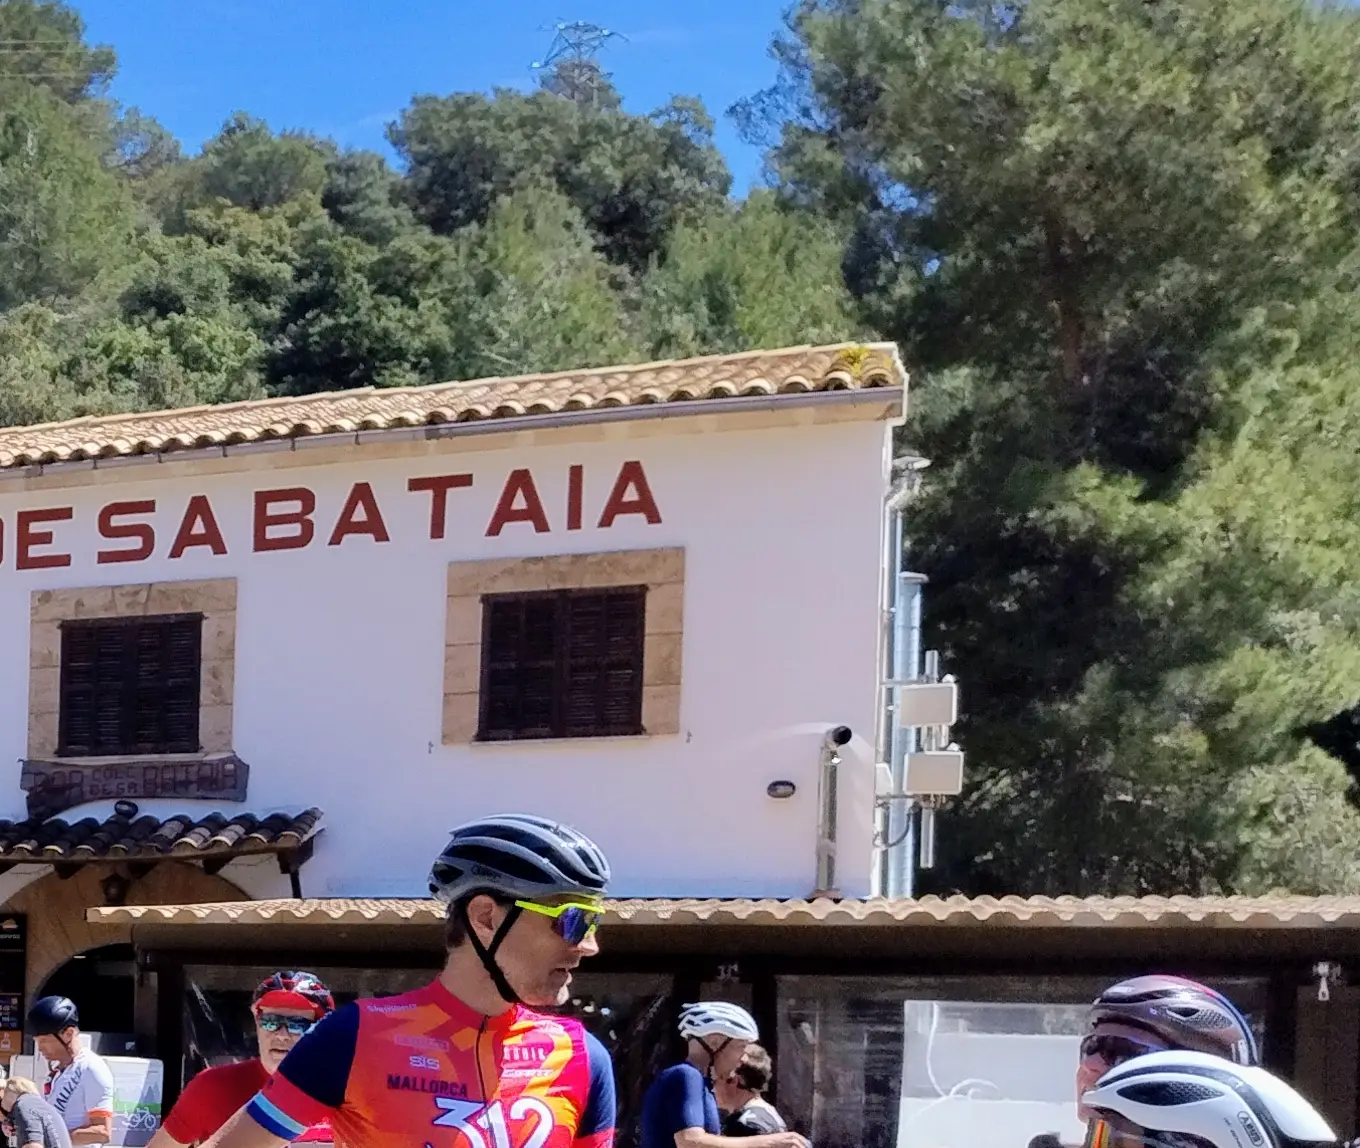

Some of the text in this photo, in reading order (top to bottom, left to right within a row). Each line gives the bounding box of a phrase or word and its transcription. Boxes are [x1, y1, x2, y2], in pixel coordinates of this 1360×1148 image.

[97, 495, 228, 565] SA
[254, 460, 662, 552] BATAIA
[387, 1073, 468, 1098] MALLORCA
